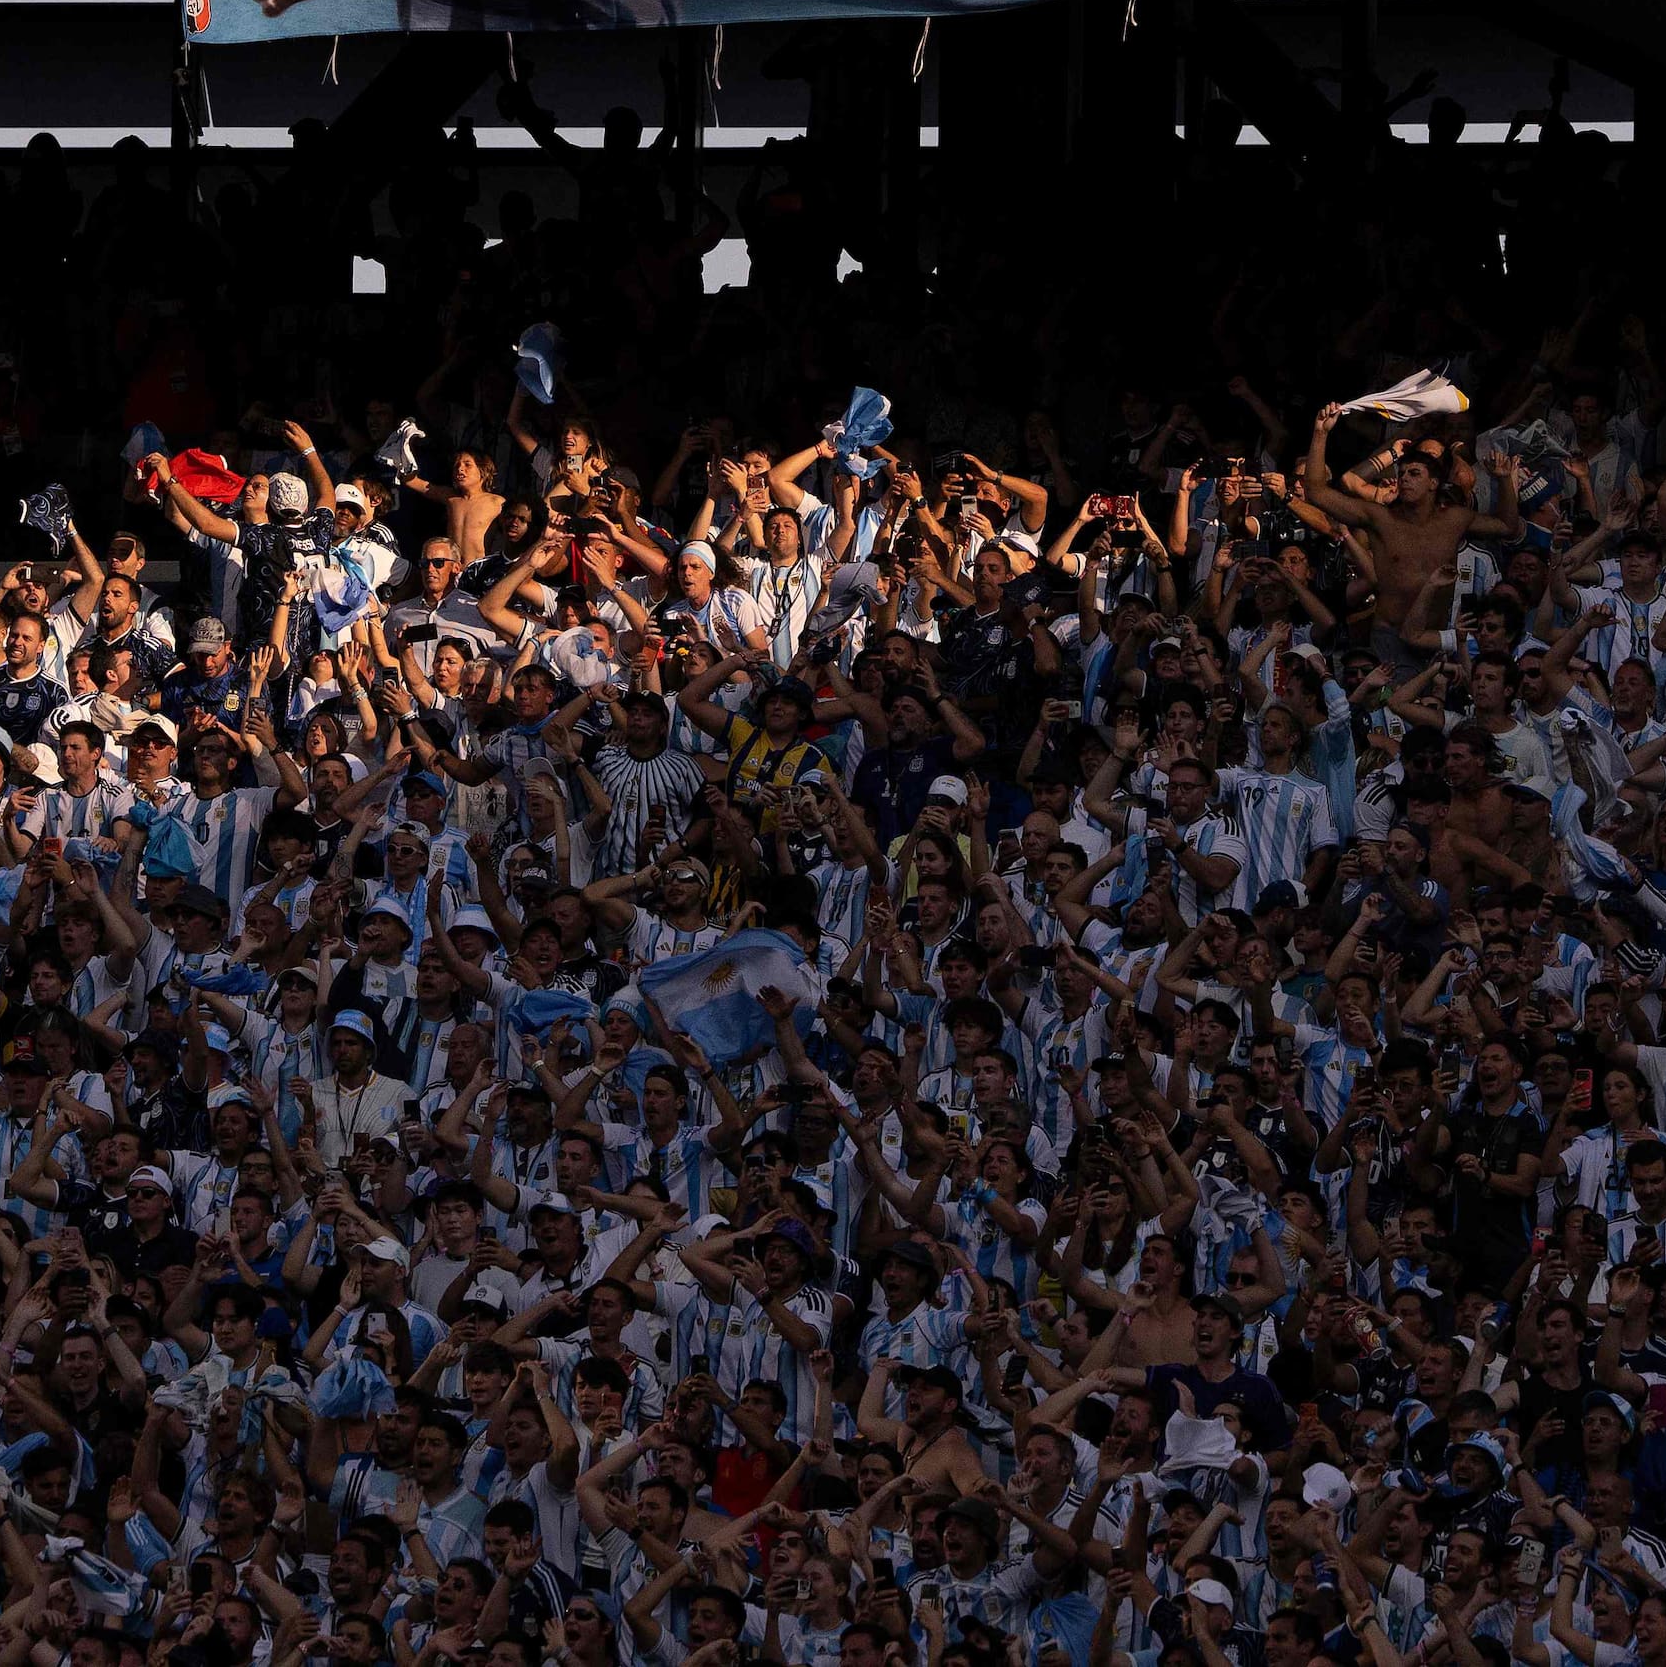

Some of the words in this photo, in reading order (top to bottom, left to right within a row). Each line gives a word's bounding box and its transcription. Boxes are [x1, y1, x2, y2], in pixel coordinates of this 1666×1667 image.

[1243, 787, 1265, 809] 19
[1048, 1047, 1069, 1070] 10
[1605, 1164, 1631, 1191] 22
